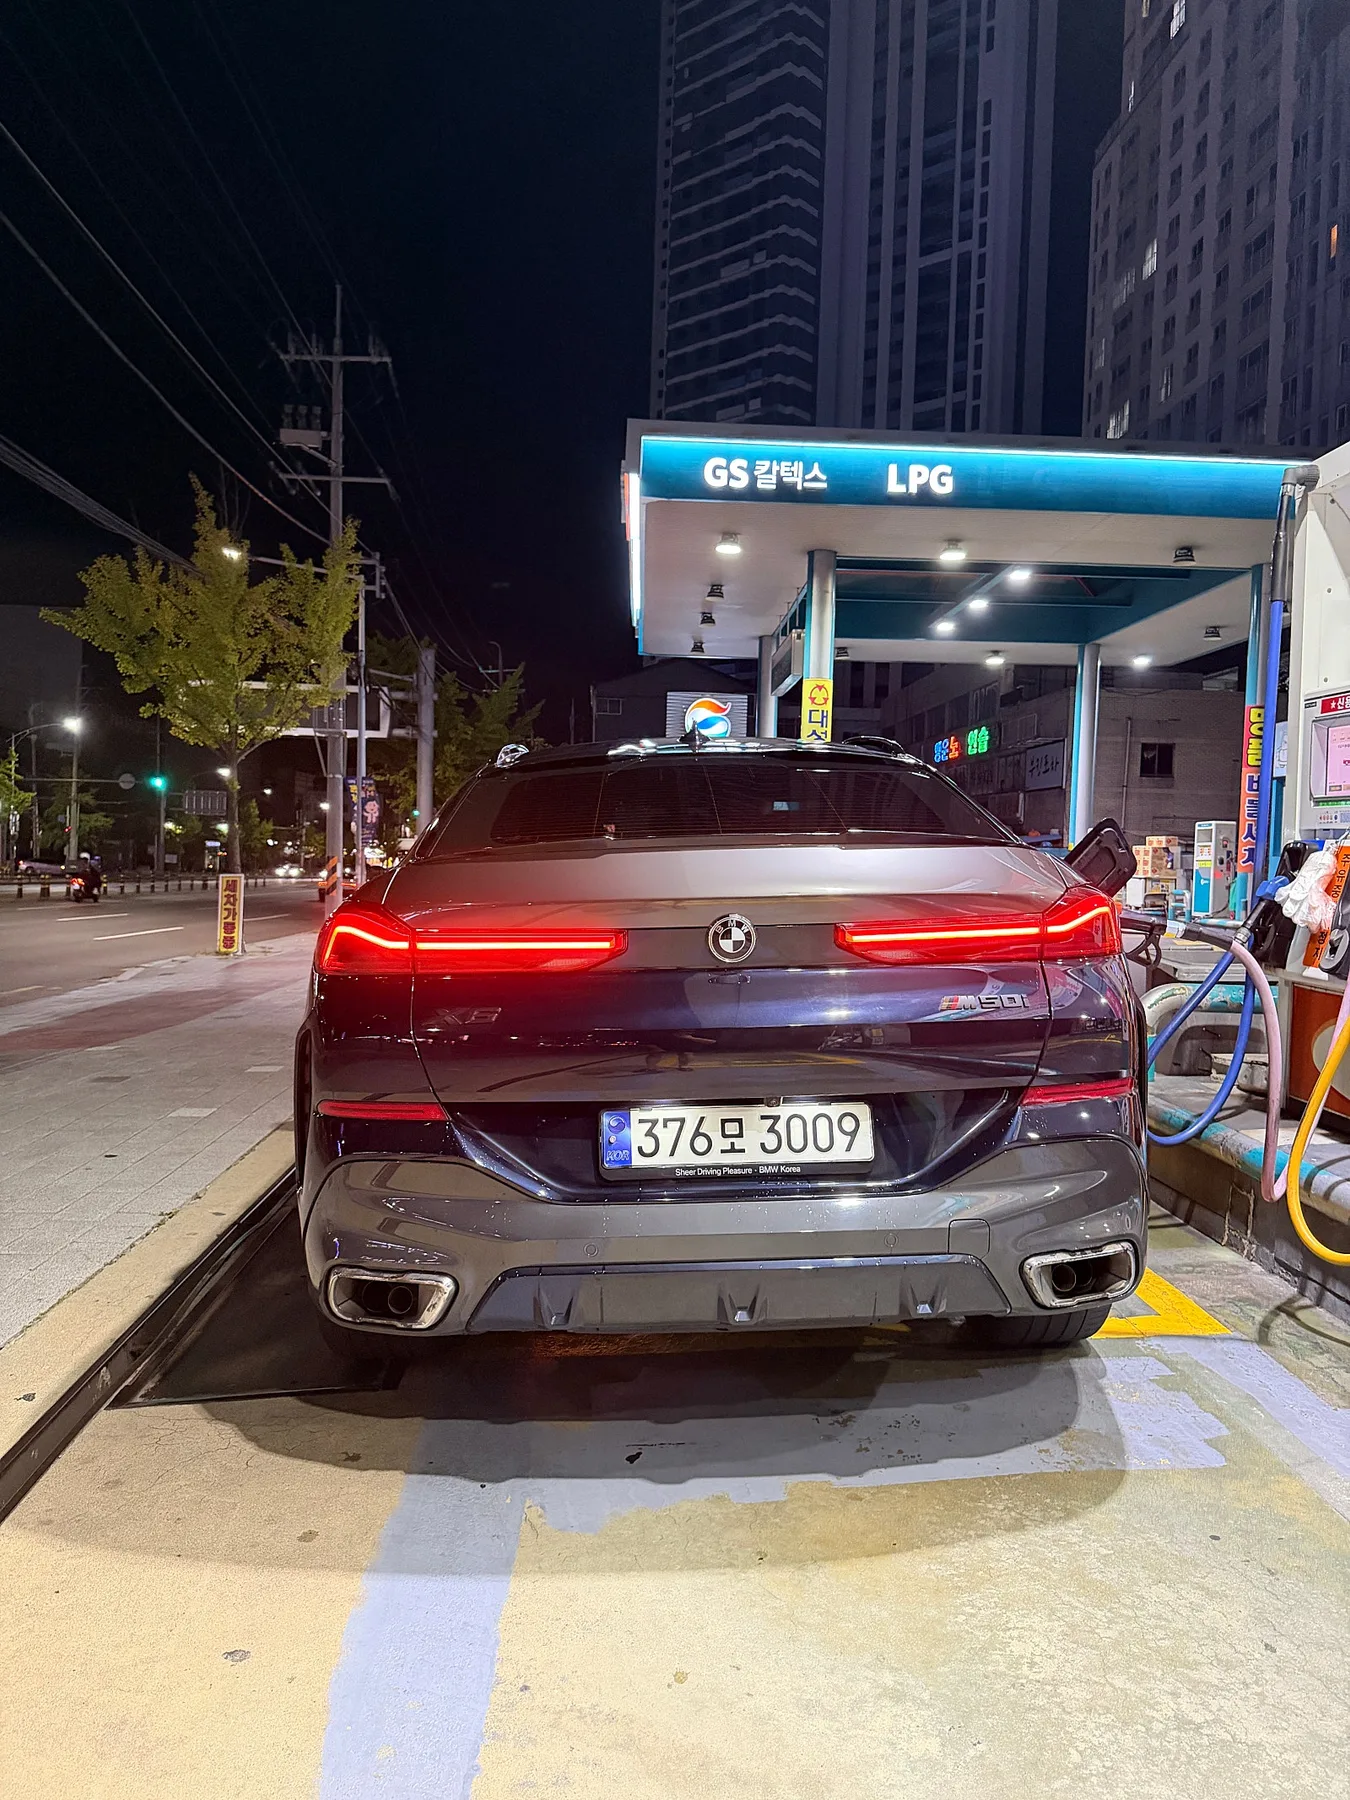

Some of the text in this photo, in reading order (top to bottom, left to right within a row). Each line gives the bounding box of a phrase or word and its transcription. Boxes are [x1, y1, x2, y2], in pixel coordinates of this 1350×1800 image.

[703, 457, 828, 491] GS 칼텍스
[887, 463, 954, 495] LPG
[715, 918, 751, 934] BMW
[637, 1111, 861, 1158] 376모 3009
[606, 1150, 629, 1162] KOR
[675, 1164, 801, 1177] Sheer Driving Pleasure BMW Korea
